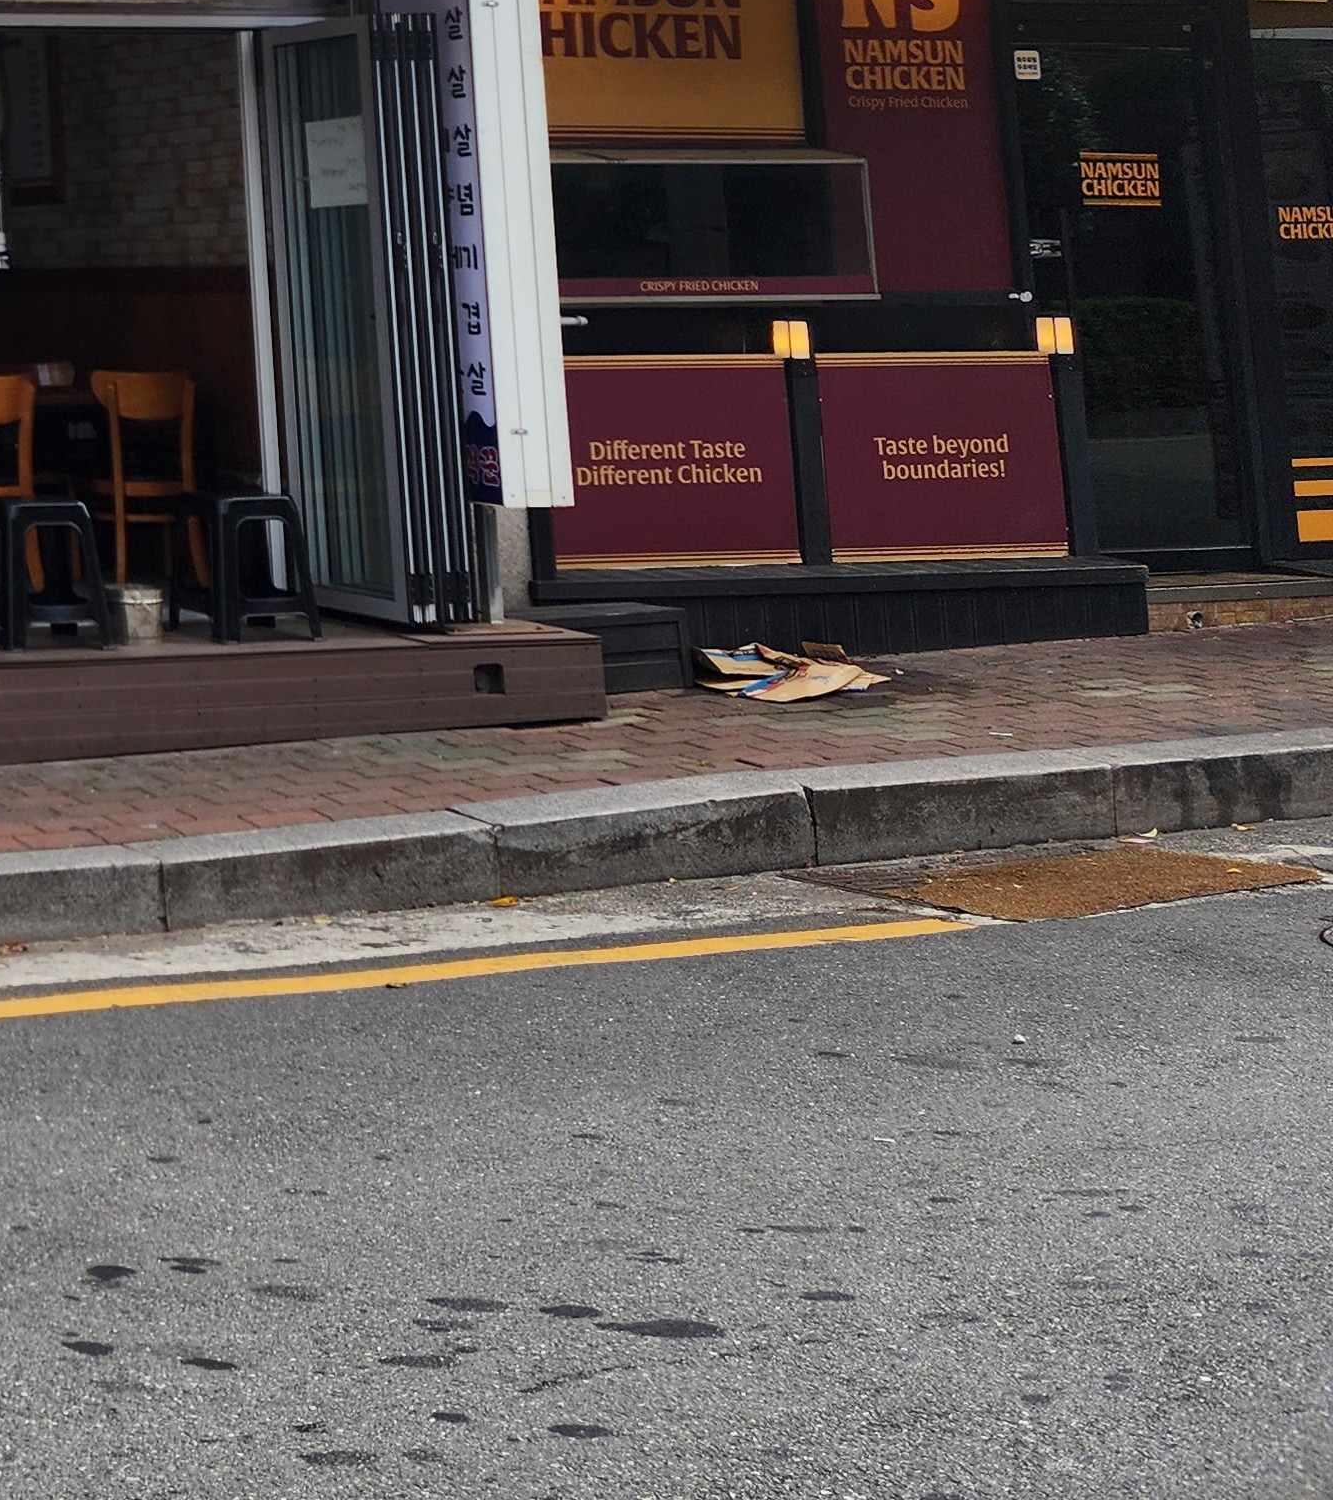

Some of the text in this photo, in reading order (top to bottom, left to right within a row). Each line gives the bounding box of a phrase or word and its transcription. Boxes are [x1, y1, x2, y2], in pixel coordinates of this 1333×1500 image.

[540, 11, 743, 60] HICKEN
[843, 39, 965, 65] NAMSUN
[845, 65, 966, 90] CHICKEN
[848, 95, 969, 111] Crispy Fried Chicken
[1079, 161, 1160, 179] NAMSUN
[1081, 179, 1161, 197] CHICKEN
[640, 280, 759, 292] CRISPY FRIED CHICKEN
[589, 440, 746, 461] Different Taste
[873, 433, 1010, 459] Taste beyond
[576, 463, 763, 486] Different Chicken
[882, 458, 1006, 480] boundaries!
